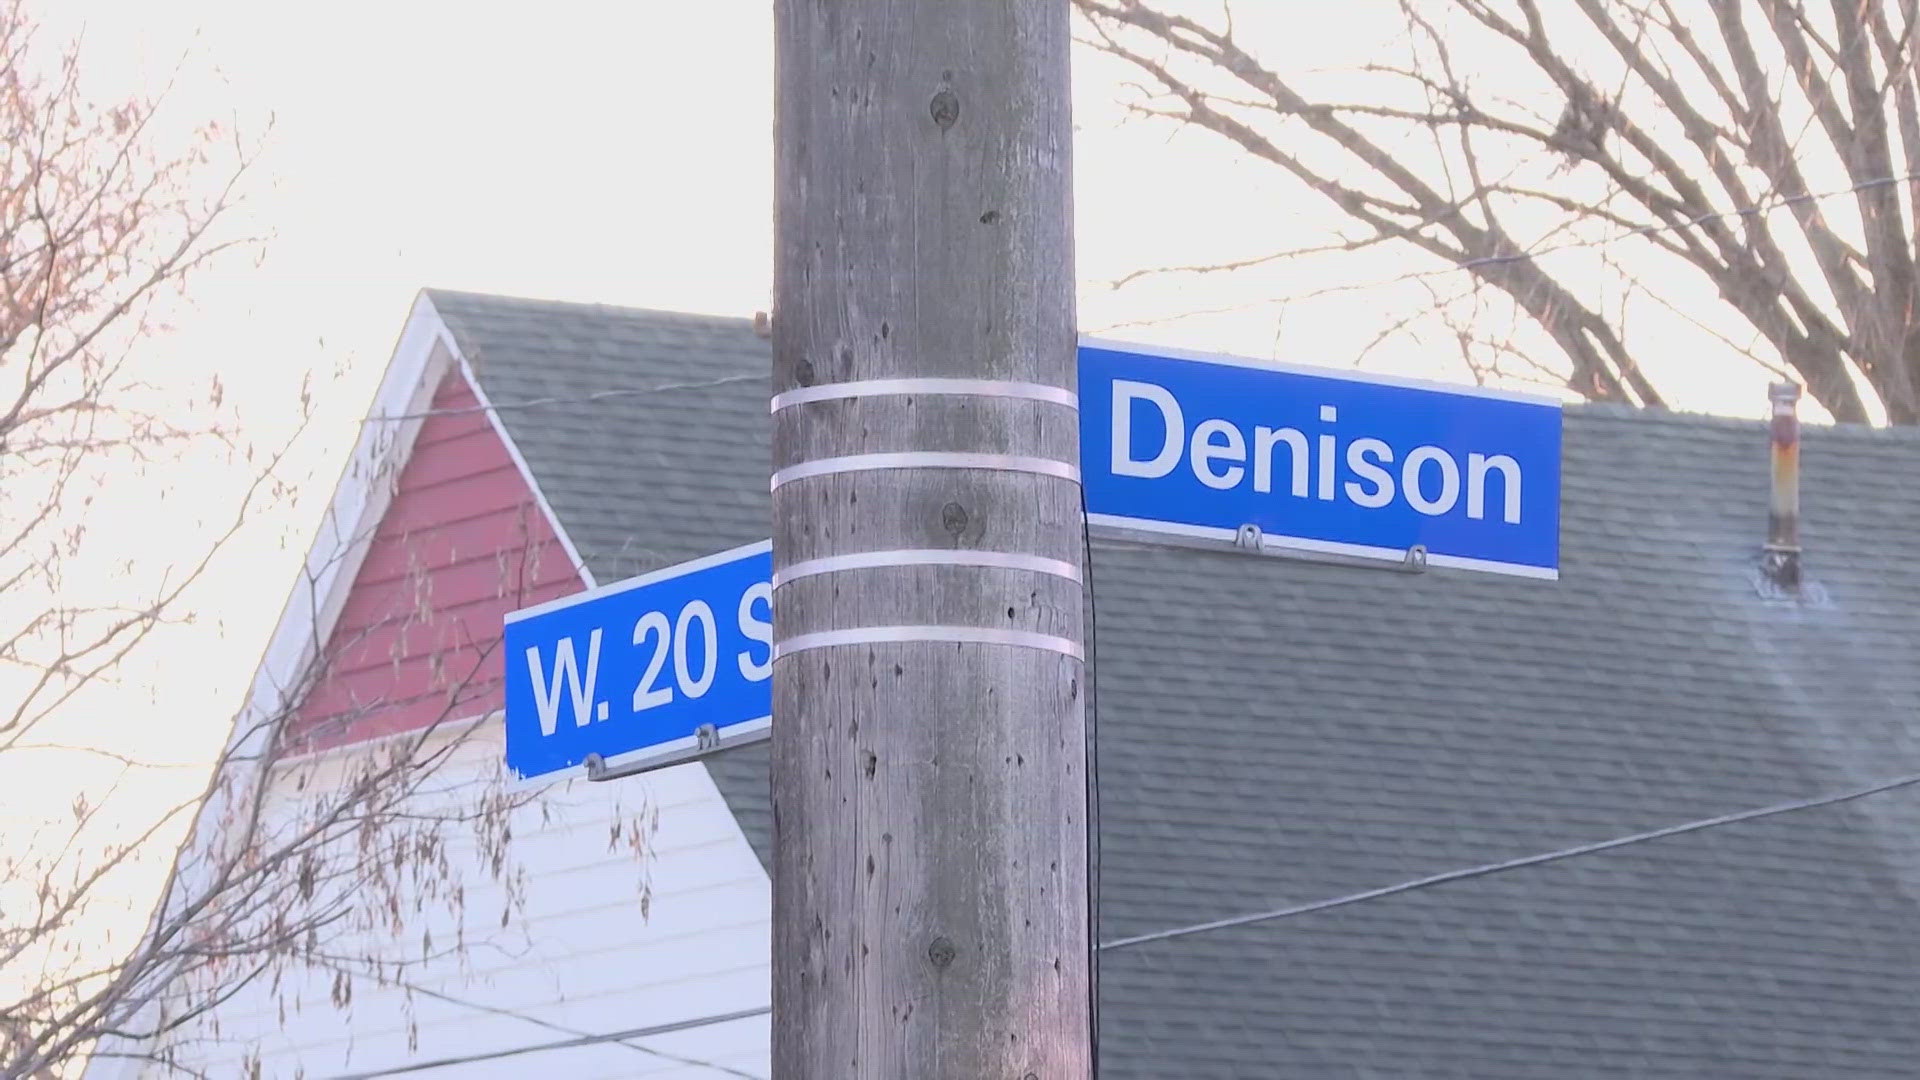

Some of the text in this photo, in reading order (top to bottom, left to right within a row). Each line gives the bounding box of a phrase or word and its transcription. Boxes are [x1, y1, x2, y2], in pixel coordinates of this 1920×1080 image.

[1110, 378, 1523, 525] Denison
[525, 627, 609, 737] W.
[632, 599, 718, 713] 20
